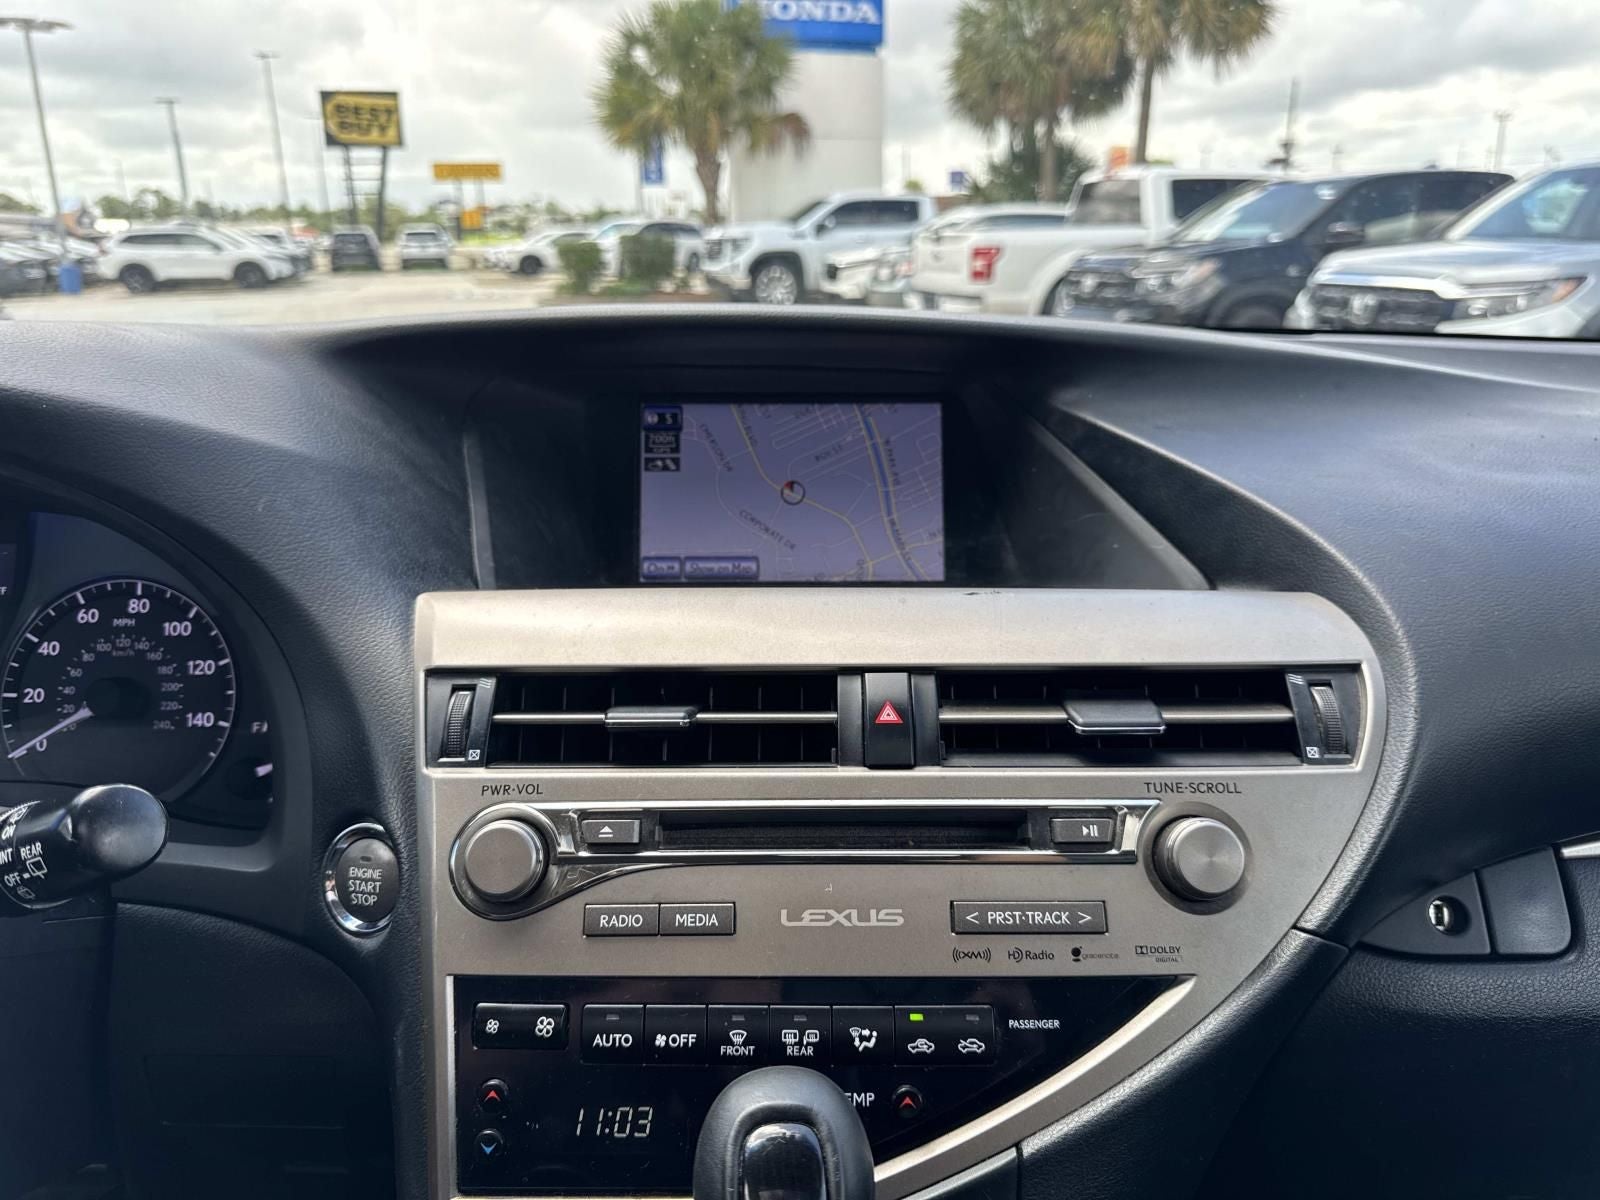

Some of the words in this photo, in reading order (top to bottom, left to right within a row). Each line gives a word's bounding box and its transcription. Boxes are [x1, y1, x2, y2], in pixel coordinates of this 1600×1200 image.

[335, 104, 395, 123] BEST
[339, 121, 391, 137] BUY
[127, 598, 150, 614] 80
[76, 608, 100, 624] 60
[113, 618, 136, 628] MPH
[163, 621, 193, 637] 100
[37, 641, 60, 656] 40
[96, 642, 112, 652] 100
[115, 638, 131, 648] 120
[134, 641, 150, 651] 140
[83, 652, 95, 662] 80
[146, 651, 163, 661] 160
[70, 667, 83, 678] 60
[158, 665, 174, 675] 180
[187, 660, 216, 676] 120
[63, 685, 76, 695] 40
[161, 682, 179, 692] 200
[23, 688, 45, 703] 20
[62, 704, 75, 713] 20
[160, 701, 179, 711] 220
[153, 720, 171, 730] 240
[185, 712, 215, 728] 140
[35, 738, 48, 752] 0
[1, 824, 17, 840] ON
[20, 841, 43, 861] REAR
[4, 872, 22, 887] OFF
[349, 866, 383, 881] ENGINE
[348, 880, 382, 894] START
[350, 892, 378, 906] STOP
[599, 913, 644, 928] RADIO
[675, 913, 719, 928] MEDIA
[780, 908, 905, 927] LEXUS
[1025, 949, 1055, 961] Radio
[1149, 945, 1181, 955] DOLBY
[1008, 1018, 1061, 1029] PASSENGER
[592, 1033, 633, 1048] AUTO
[668, 1033, 697, 1048] OFF
[720, 1045, 755, 1057] FRONT
[786, 1045, 814, 1057] REAR
[575, 1105, 654, 1138] 11:03
